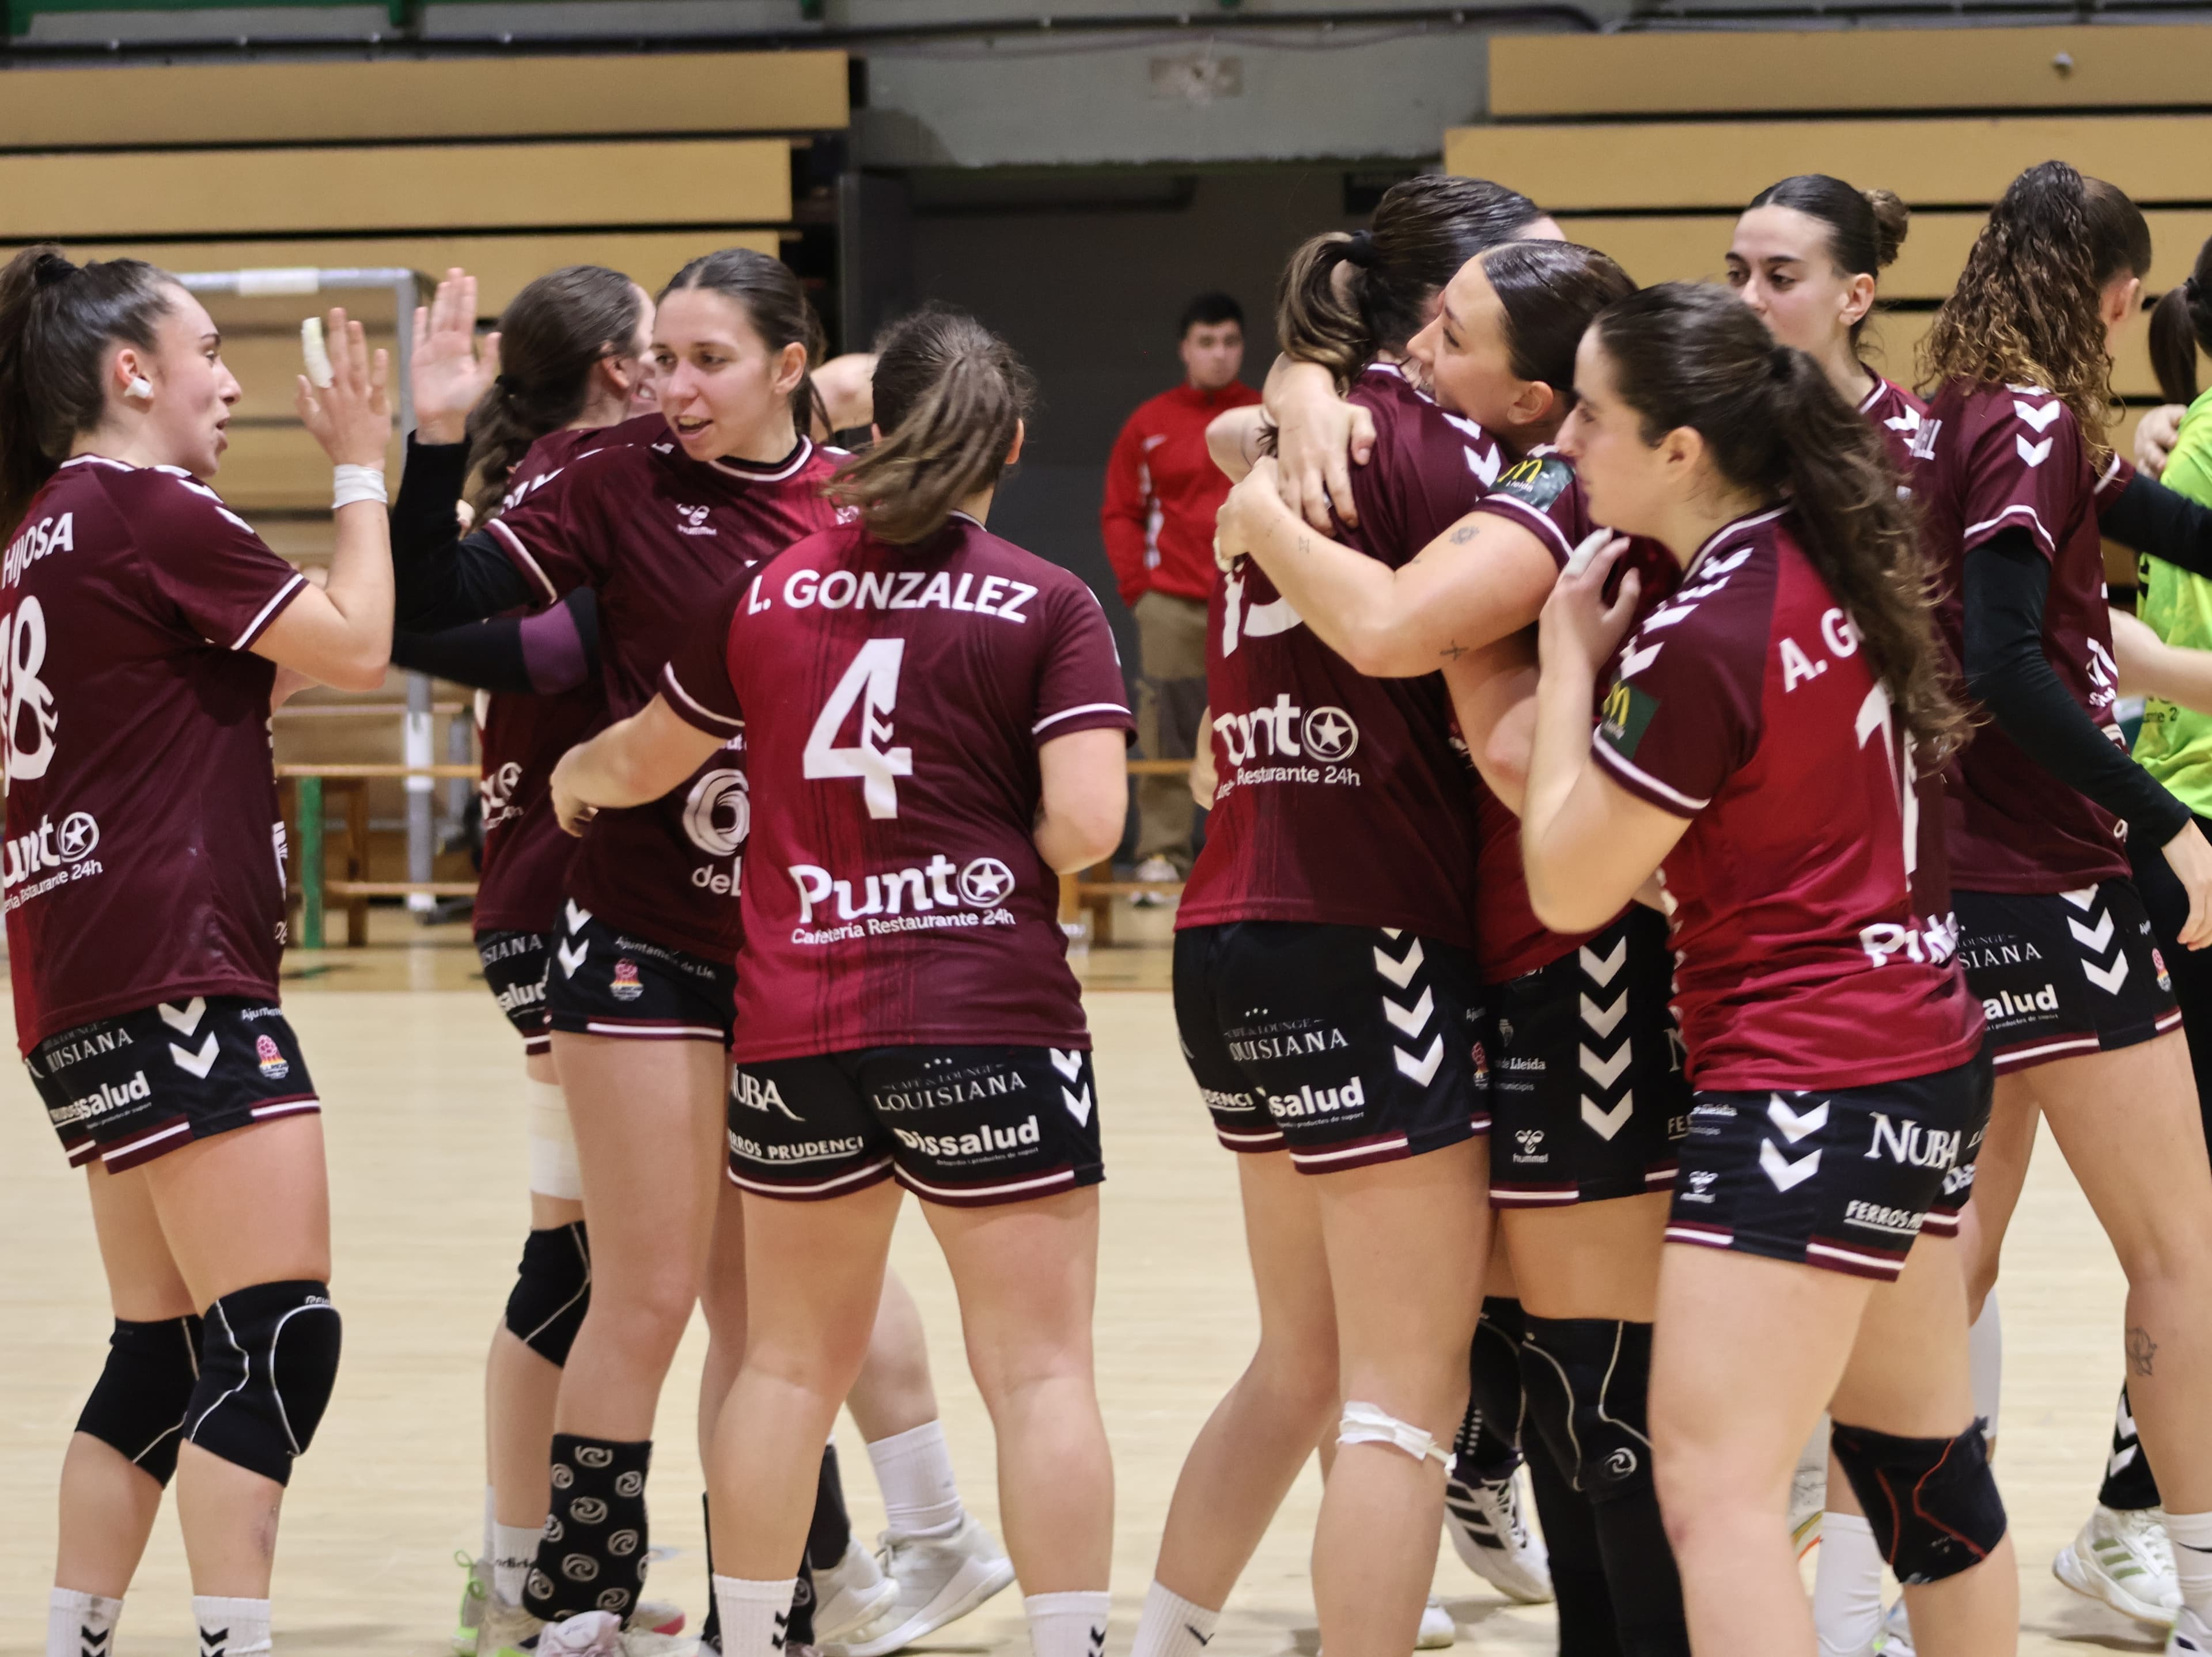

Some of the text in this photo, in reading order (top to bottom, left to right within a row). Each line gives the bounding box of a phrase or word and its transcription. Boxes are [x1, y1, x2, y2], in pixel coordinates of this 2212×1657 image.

[1, 511, 74, 590] HIJOSA
[748, 569, 1039, 624] L. GONZALEZ
[1778, 607, 1866, 693] A. G
[803, 638, 913, 819] 4
[1324, 765, 1361, 787] 24h
[71, 859, 103, 881] 24h
[867, 912, 979, 935] Restaurante
[982, 908, 1016, 926] 24h
[1509, 1057, 1547, 1070] Lleida
[873, 1071, 1028, 1112] LOUISIANA
[767, 1135, 864, 1160] PRUDENCI
[893, 1114, 1041, 1157] Dissalud
